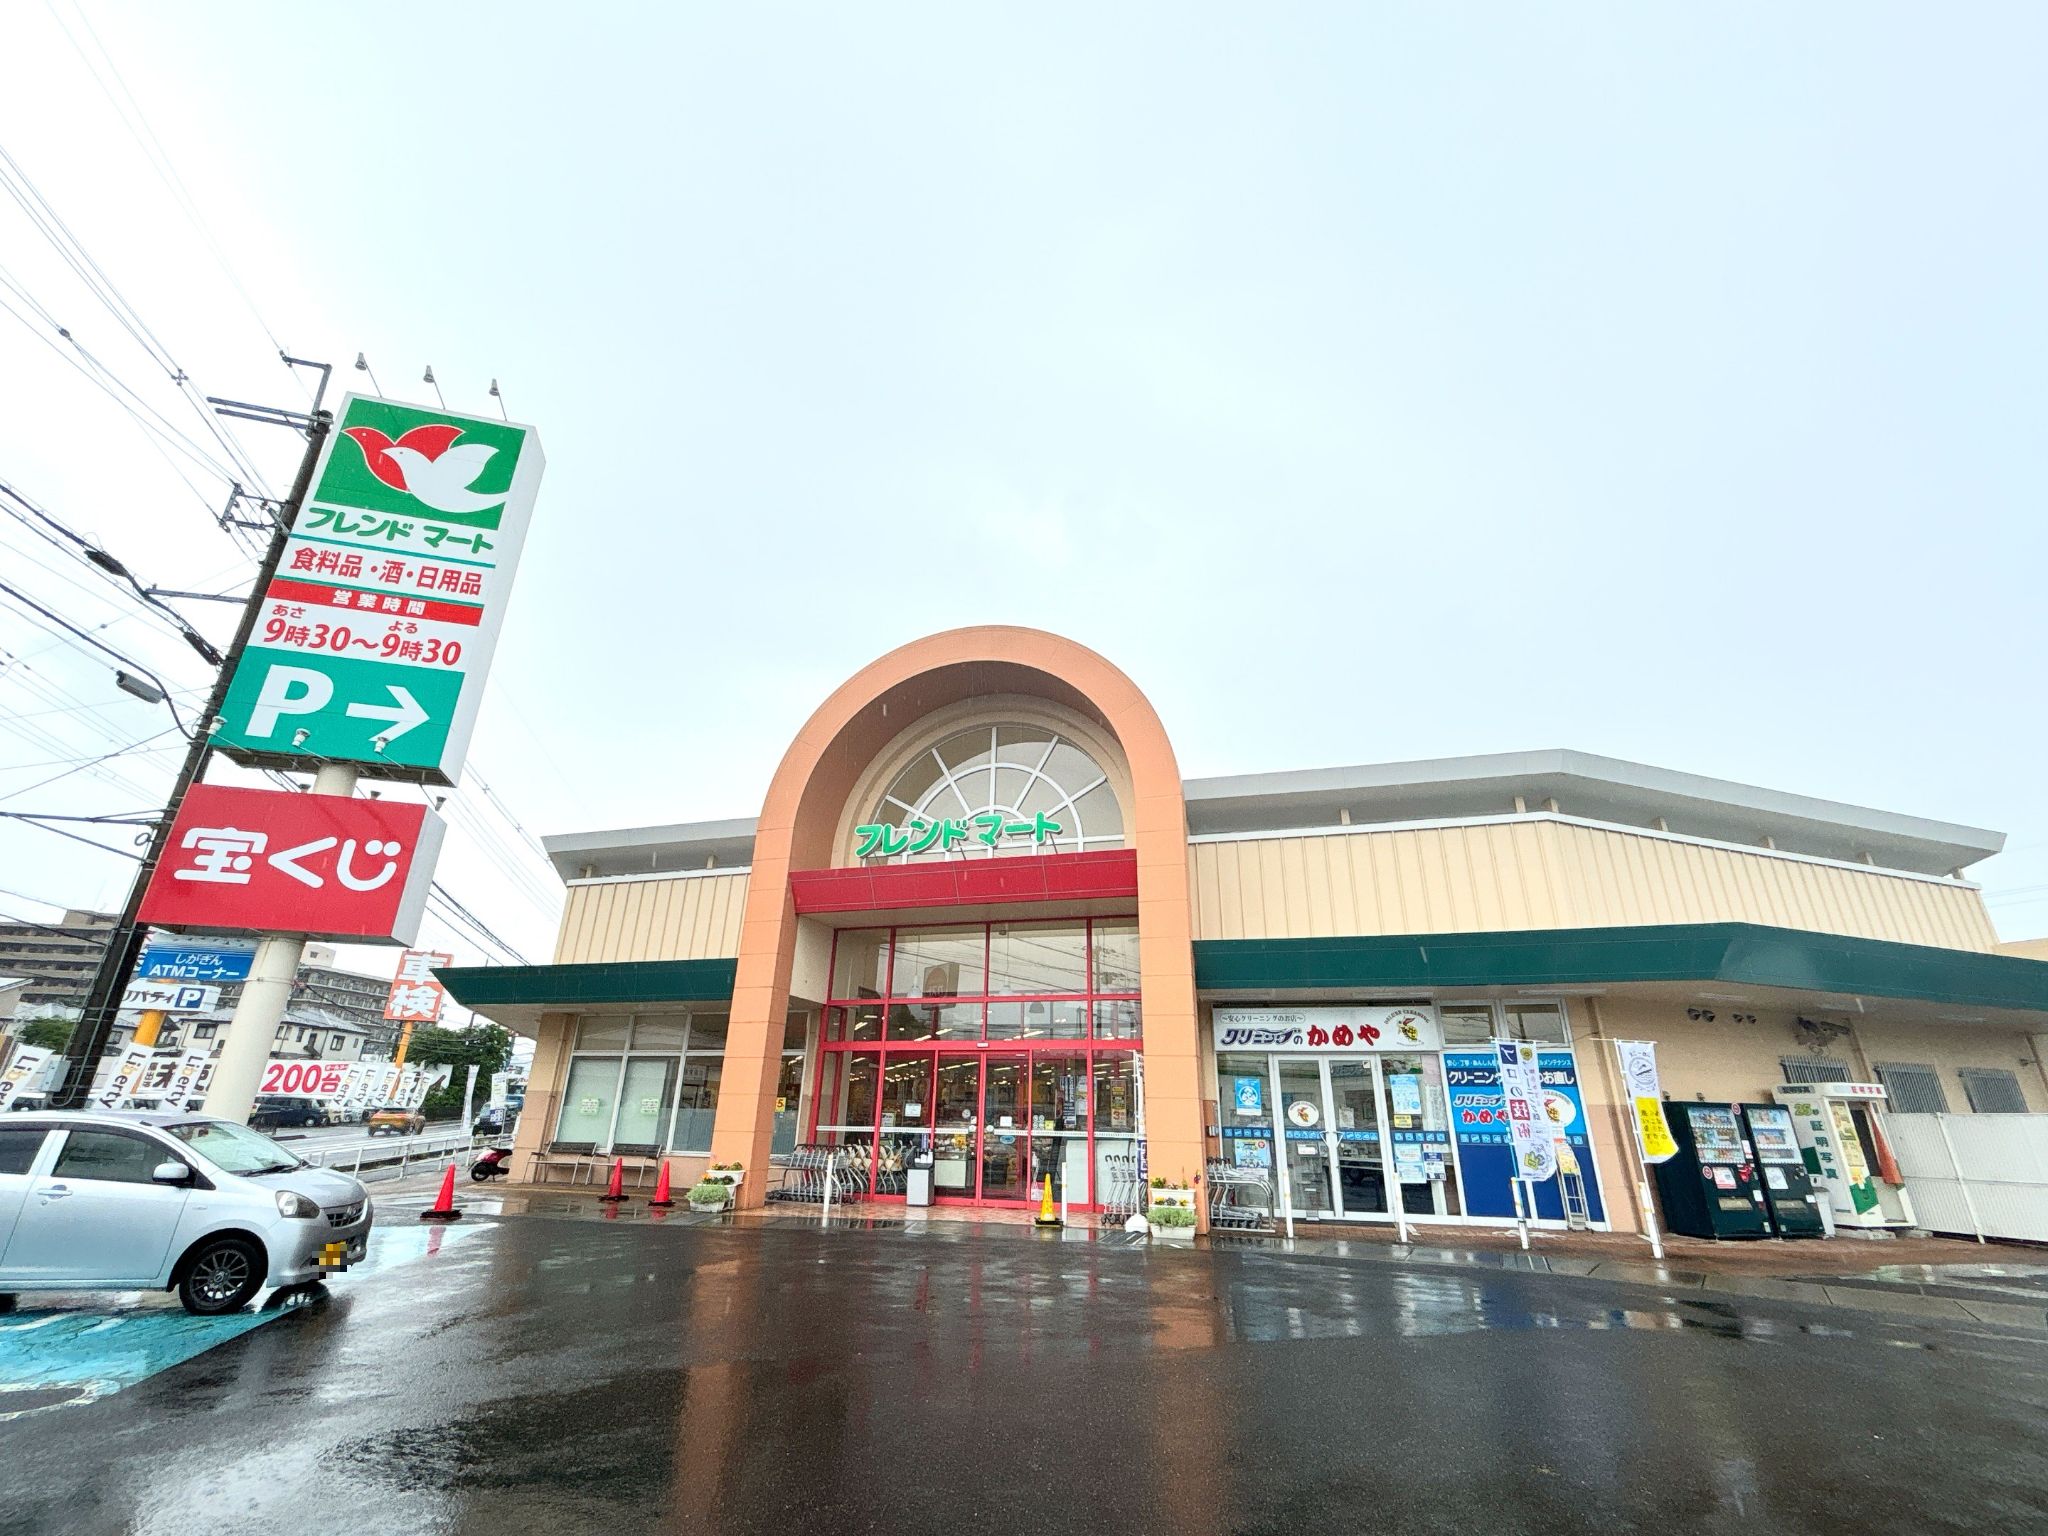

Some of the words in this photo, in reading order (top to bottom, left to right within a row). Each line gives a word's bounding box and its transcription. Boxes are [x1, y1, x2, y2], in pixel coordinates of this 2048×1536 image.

[304, 507, 413, 541] フレンド
[423, 525, 494, 555] マート
[289, 547, 483, 596] 食料品・酒・日用品
[271, 603, 306, 619] あさ
[332, 589, 426, 617] 営業時間
[388, 620, 418, 635] よる
[244, 663, 334, 738] P
[854, 818, 968, 857] フレンド
[974, 811, 1063, 847] マート
[173, 826, 401, 892] 宝くじ
[149, 964, 240, 979] ATMコーナー
[175, 953, 223, 966] しがぎん
[179, 988, 204, 1008] P
[389, 953, 448, 1019] 車検
[261, 1064, 342, 1094] 200台
[1810, 1120, 1839, 1180] 証明写真
